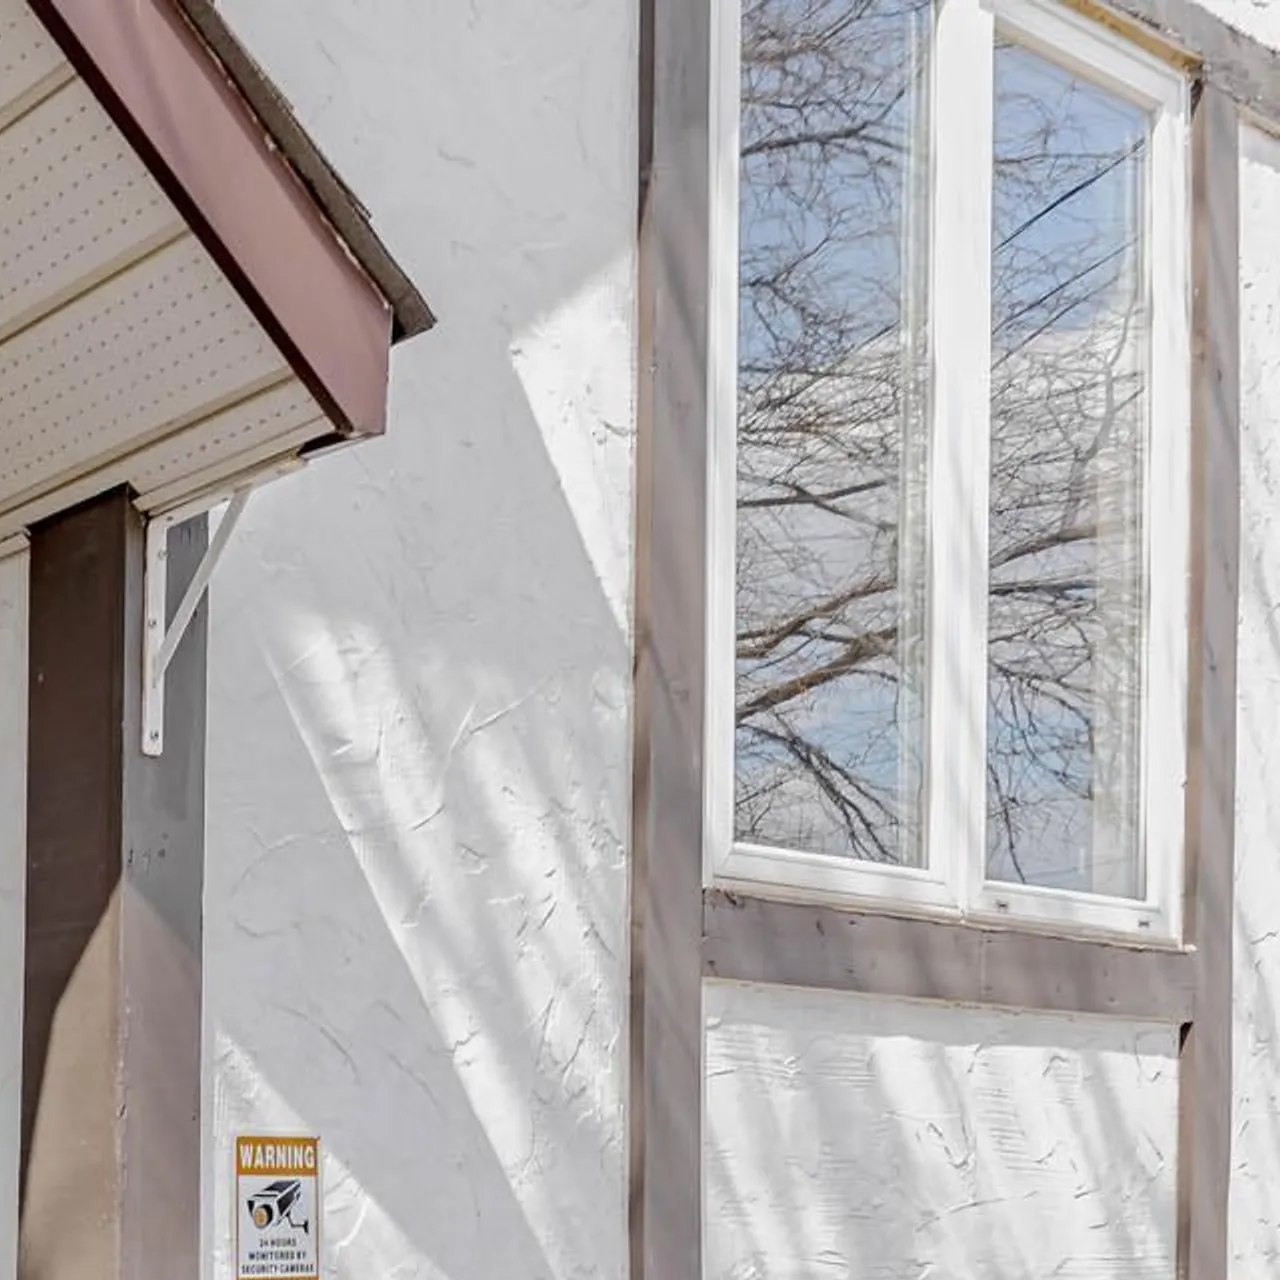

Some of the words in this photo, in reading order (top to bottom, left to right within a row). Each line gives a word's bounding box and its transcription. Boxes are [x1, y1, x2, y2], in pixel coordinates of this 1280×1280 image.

[241, 1144, 315, 1169] WARNING
[249, 1251, 294, 1261] MONITORED
[297, 1251, 306, 1260] BY
[242, 1264, 278, 1274] SECURITY
